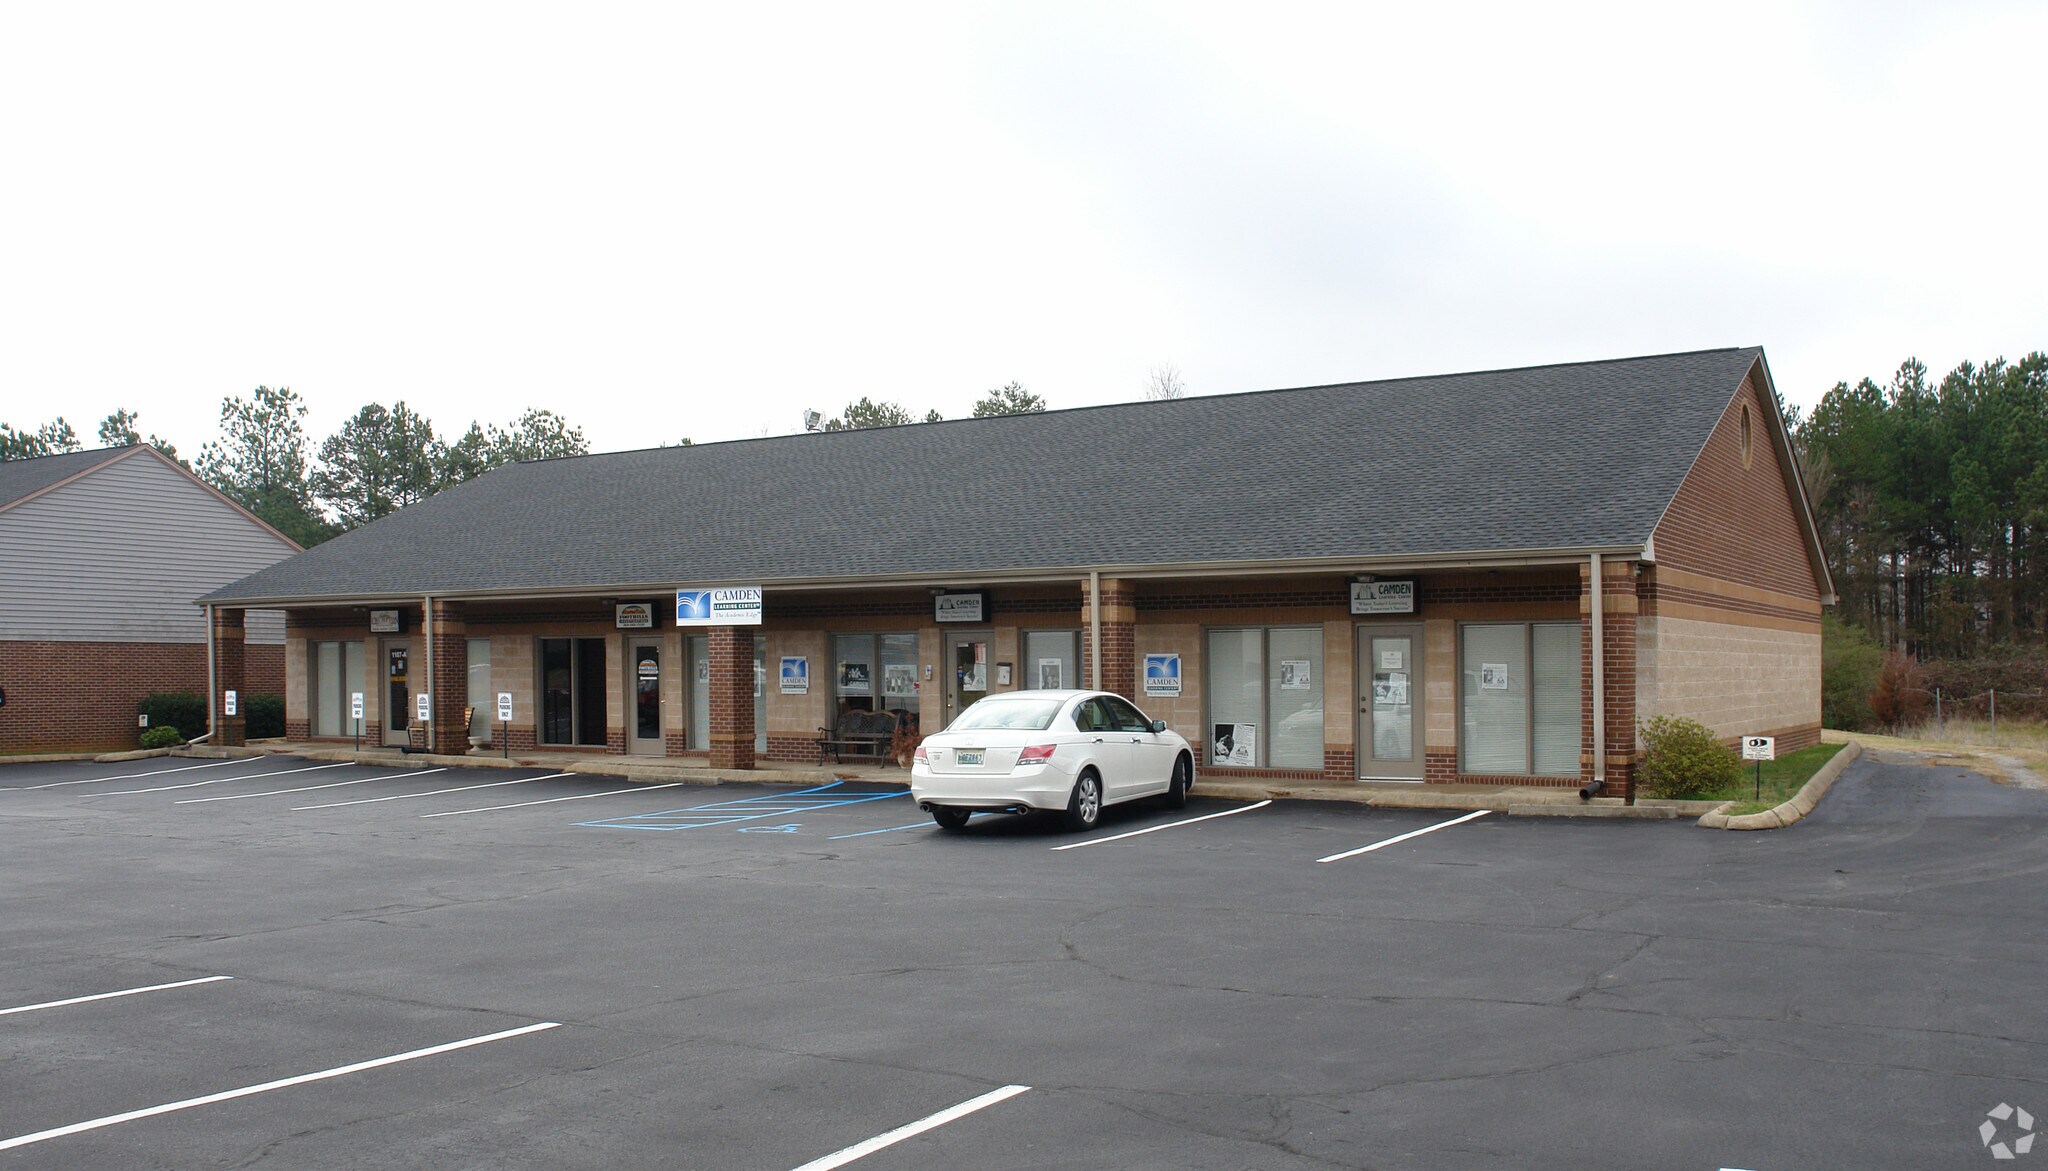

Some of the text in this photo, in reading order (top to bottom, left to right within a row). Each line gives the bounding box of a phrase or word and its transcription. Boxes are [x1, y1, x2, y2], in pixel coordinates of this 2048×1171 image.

[714, 589, 761, 601] CAMDEN
[1378, 584, 1411, 595] CAMDEN
[1146, 678, 1179, 686] CAMDEN
